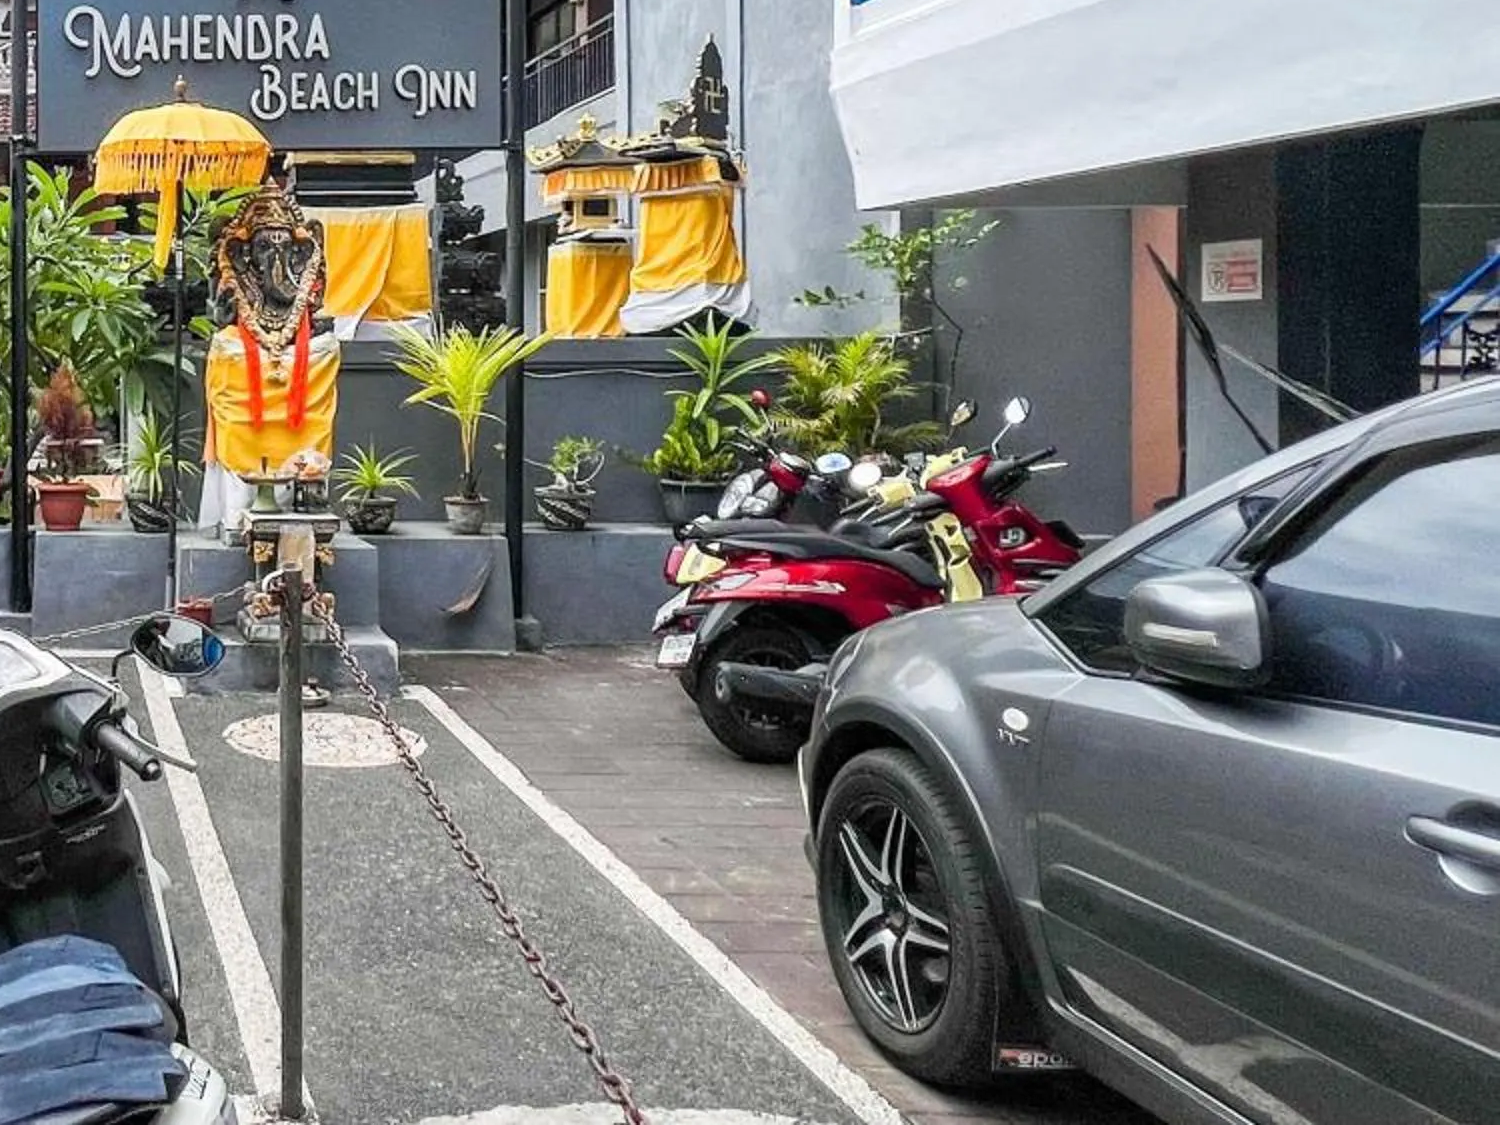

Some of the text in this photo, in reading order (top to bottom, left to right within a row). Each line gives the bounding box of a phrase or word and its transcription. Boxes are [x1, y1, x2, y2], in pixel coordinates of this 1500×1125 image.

[64, 5, 331, 78] MAHENDRA
[250, 63, 477, 121] BEACH INN
